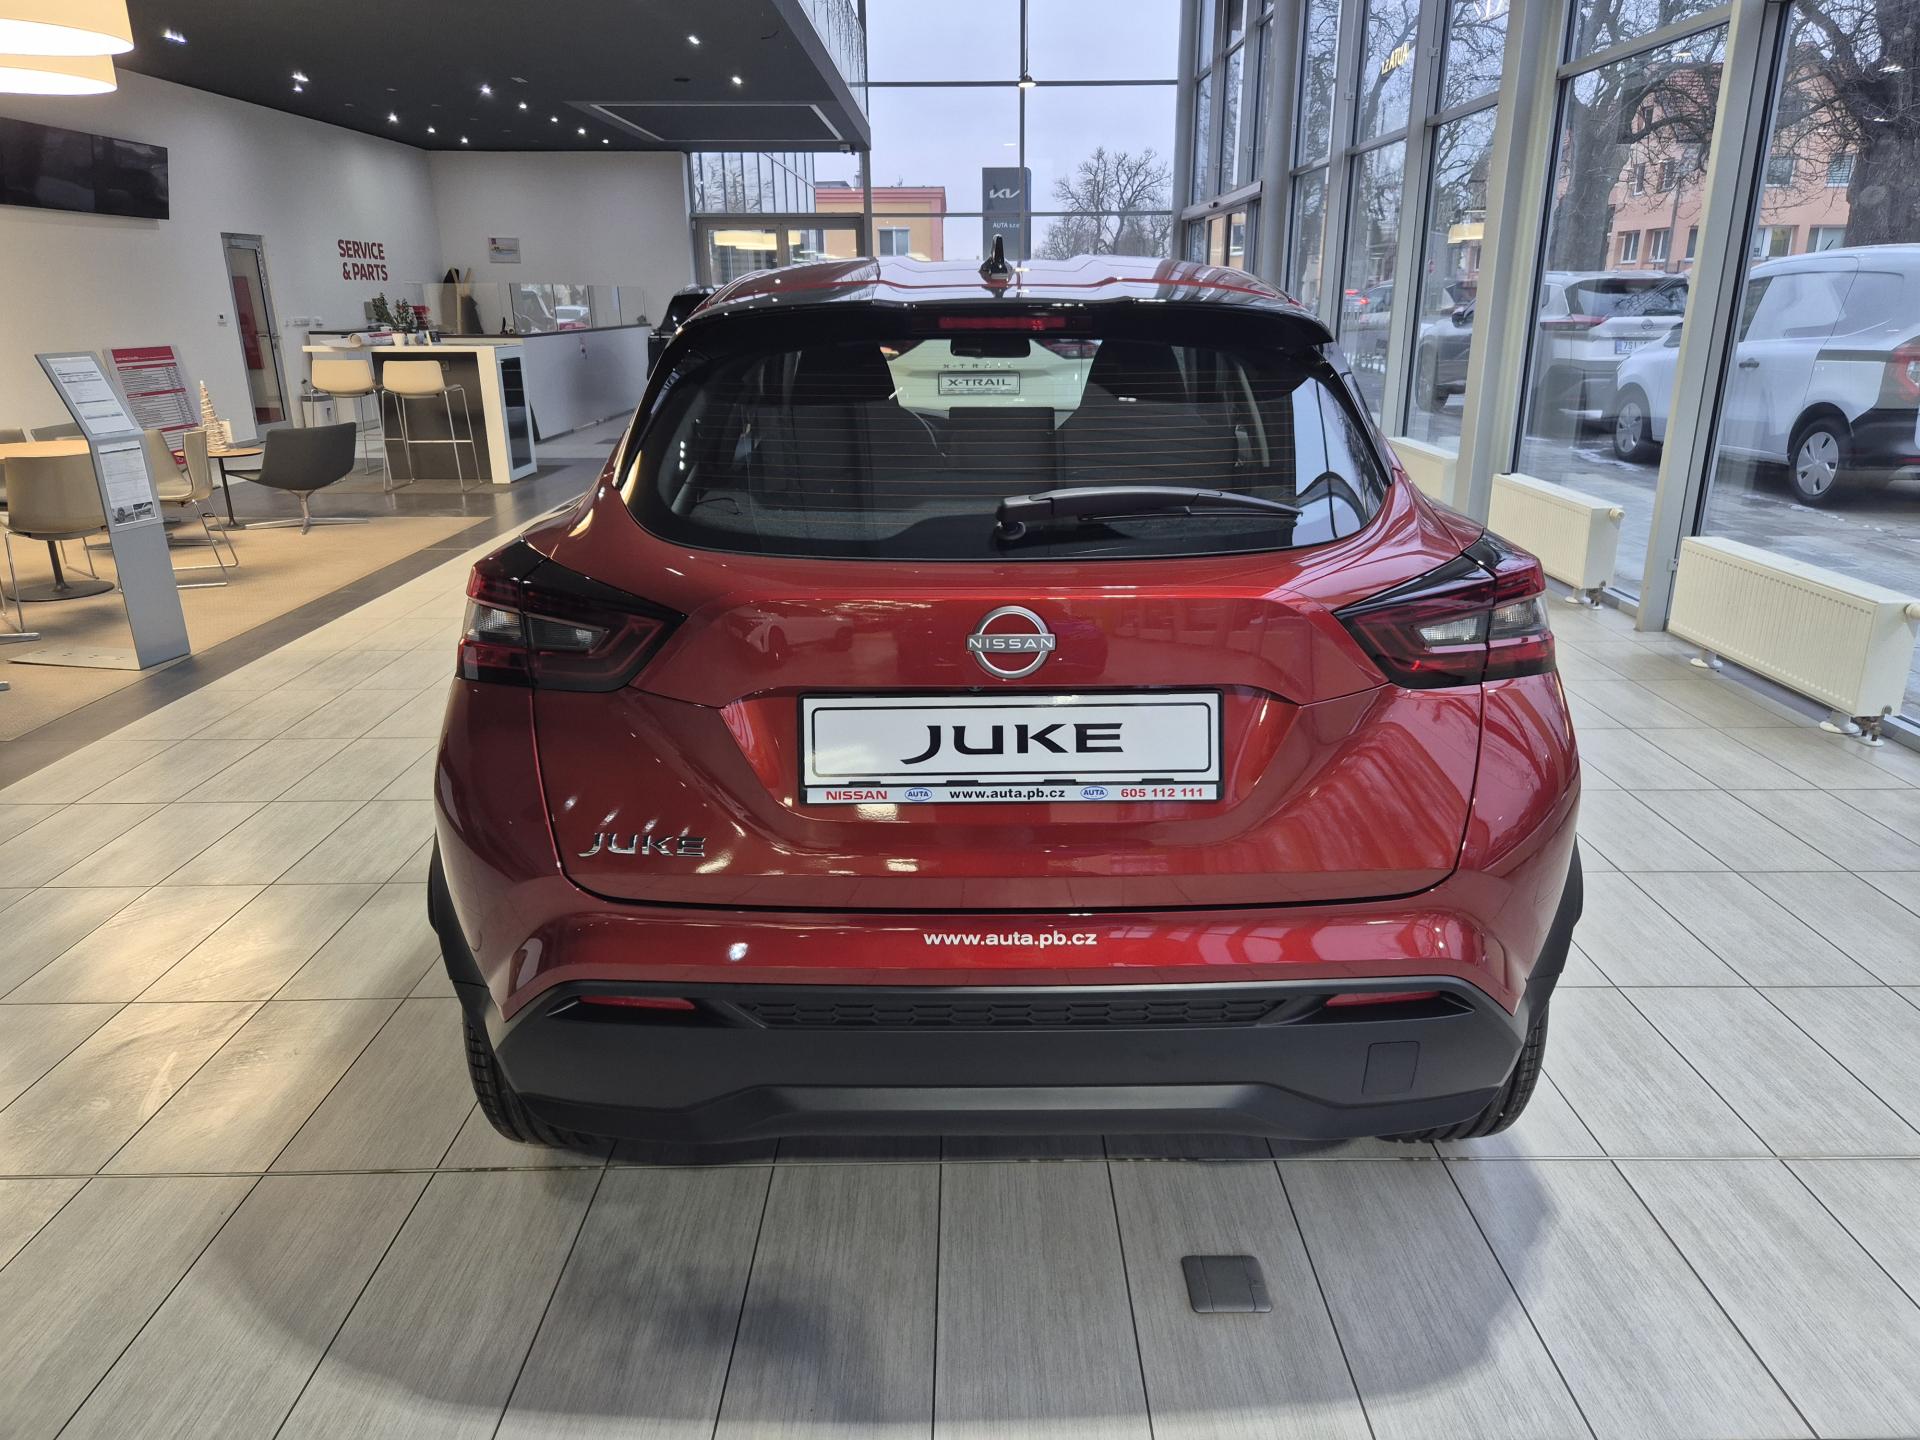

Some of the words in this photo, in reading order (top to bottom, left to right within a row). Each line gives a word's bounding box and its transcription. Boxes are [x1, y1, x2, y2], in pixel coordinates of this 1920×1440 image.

[337, 239, 386, 261] SERVICE
[342, 262, 352, 281] &
[352, 262, 389, 282] PARTS
[948, 378, 1012, 387] X-TRAIL
[969, 638, 1053, 649] NISSAN
[900, 723, 1124, 765] JUKE
[826, 790, 888, 800] NISSAN
[907, 791, 929, 799] AUTA
[949, 788, 1065, 800] www.auta.pb.cz
[1083, 789, 1105, 797] AUTA
[1120, 788, 1146, 798] 605
[1152, 788, 1176, 798] 112
[1180, 788, 1204, 798] 111
[577, 832, 706, 858] JUKE
[923, 930, 1097, 949] www.auta.pb.cz
